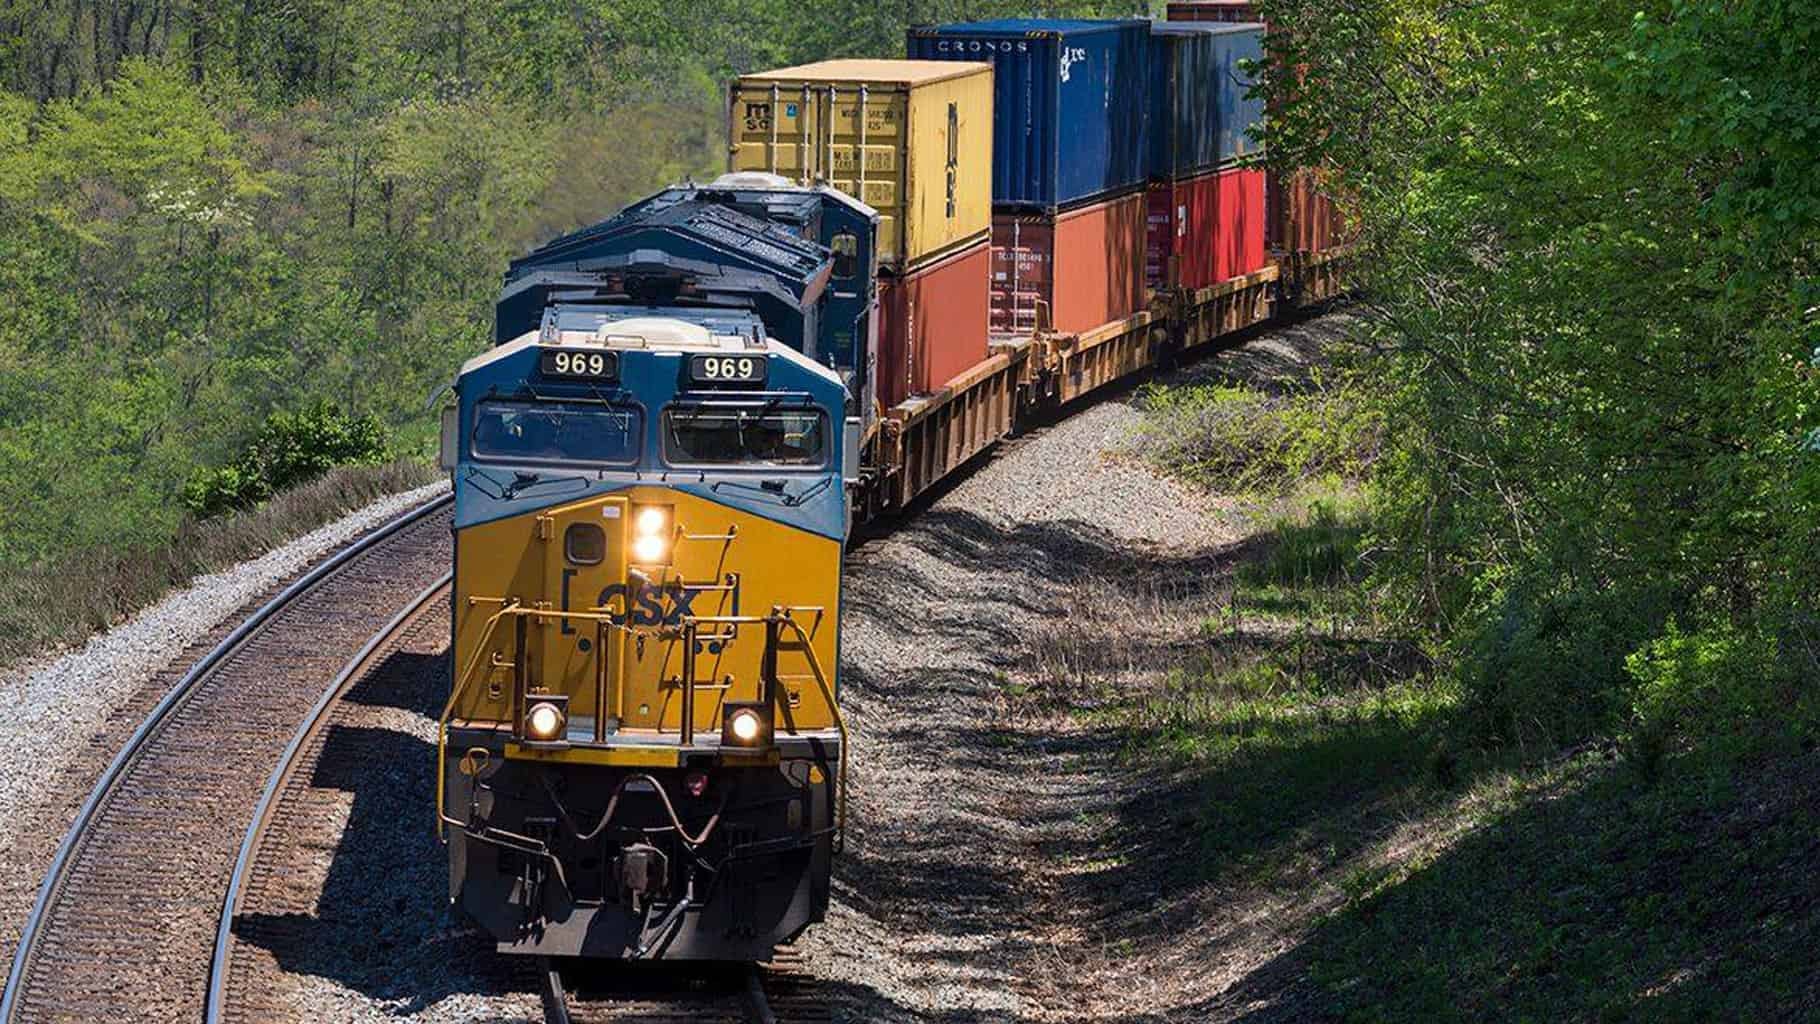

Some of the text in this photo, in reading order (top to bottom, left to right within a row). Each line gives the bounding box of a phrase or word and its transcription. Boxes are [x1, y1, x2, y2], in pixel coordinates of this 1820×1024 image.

[555, 352, 604, 375] 969
[704, 358, 753, 378] 969
[597, 583, 701, 626] CSX
